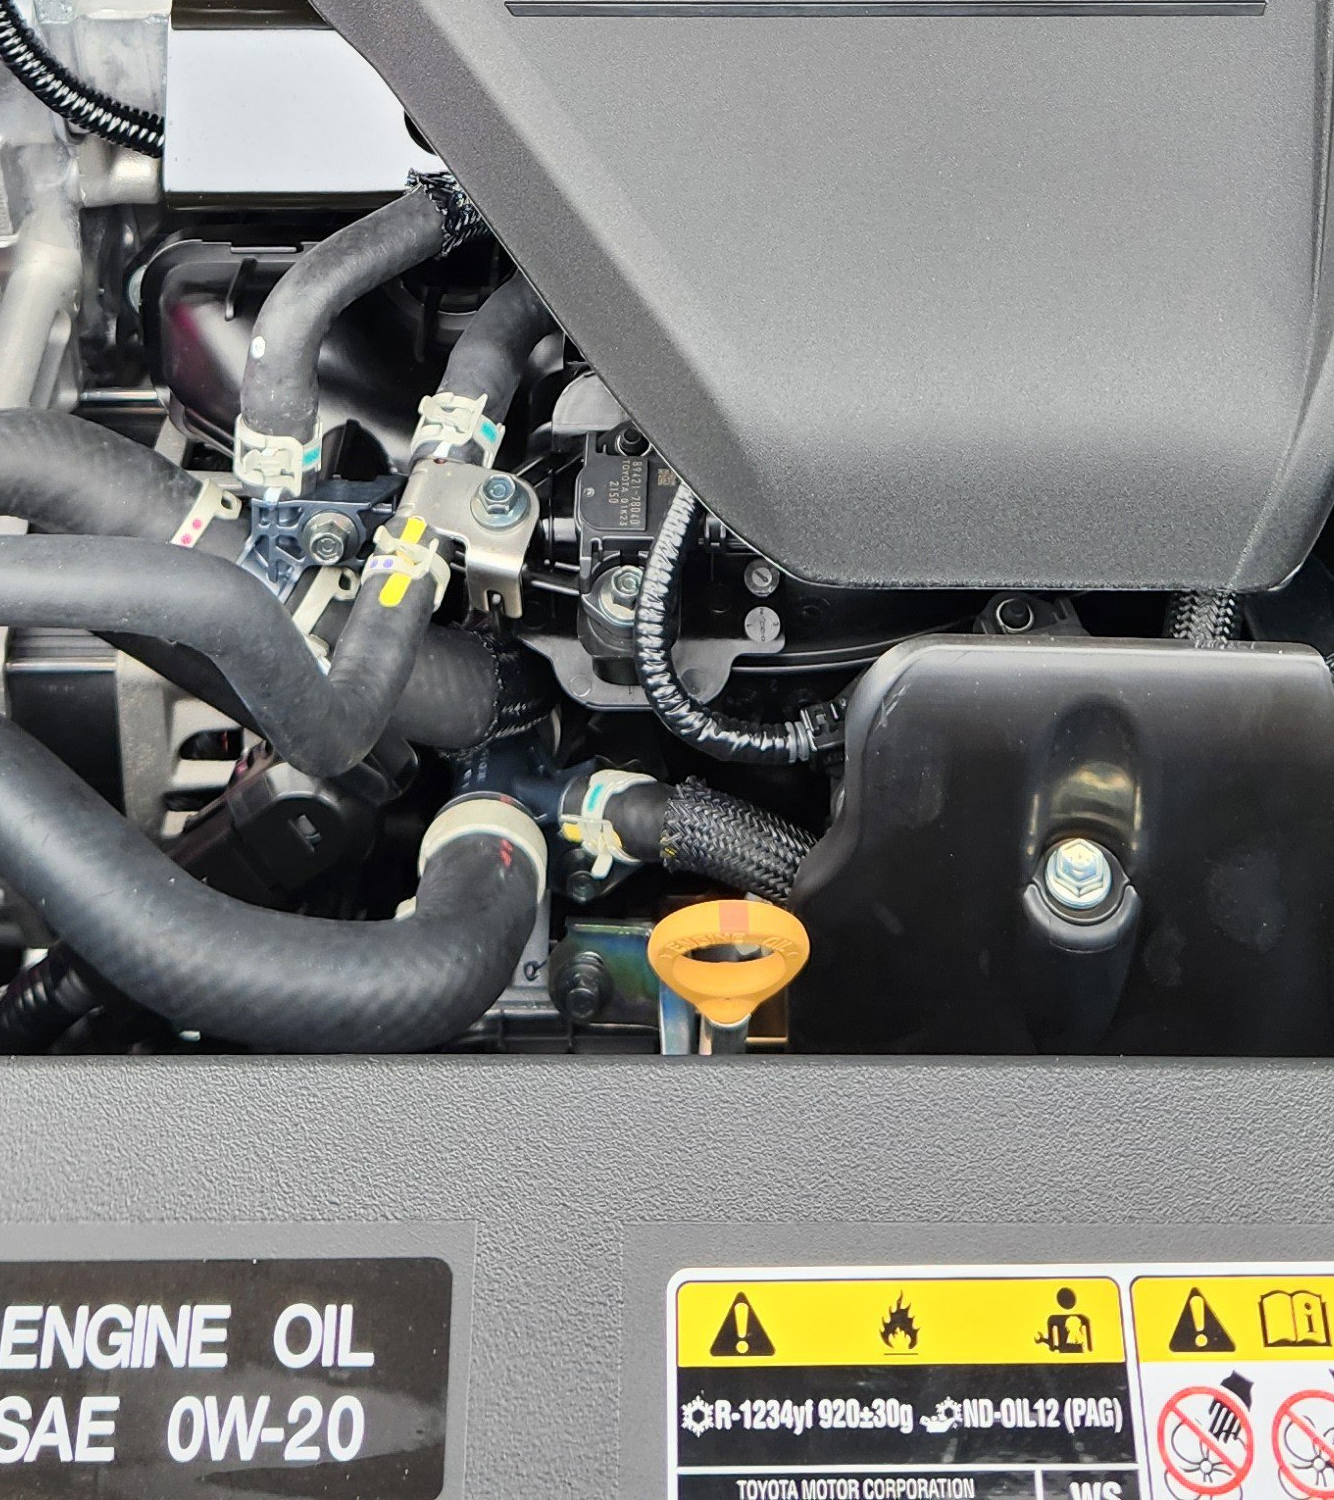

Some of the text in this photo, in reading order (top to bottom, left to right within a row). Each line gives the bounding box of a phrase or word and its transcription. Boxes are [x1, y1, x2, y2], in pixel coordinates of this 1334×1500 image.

[665, 931, 794, 955] ENGINE OIL
[272, 1302, 375, 1368] OIL
[167, 1394, 365, 1463] 0W-20
[714, 1396, 1123, 1435] R-1234yf 920±30g ND-OIL12 (PAG)
[736, 1477, 975, 1500] TOYOTA MOTOR CORPORATION
